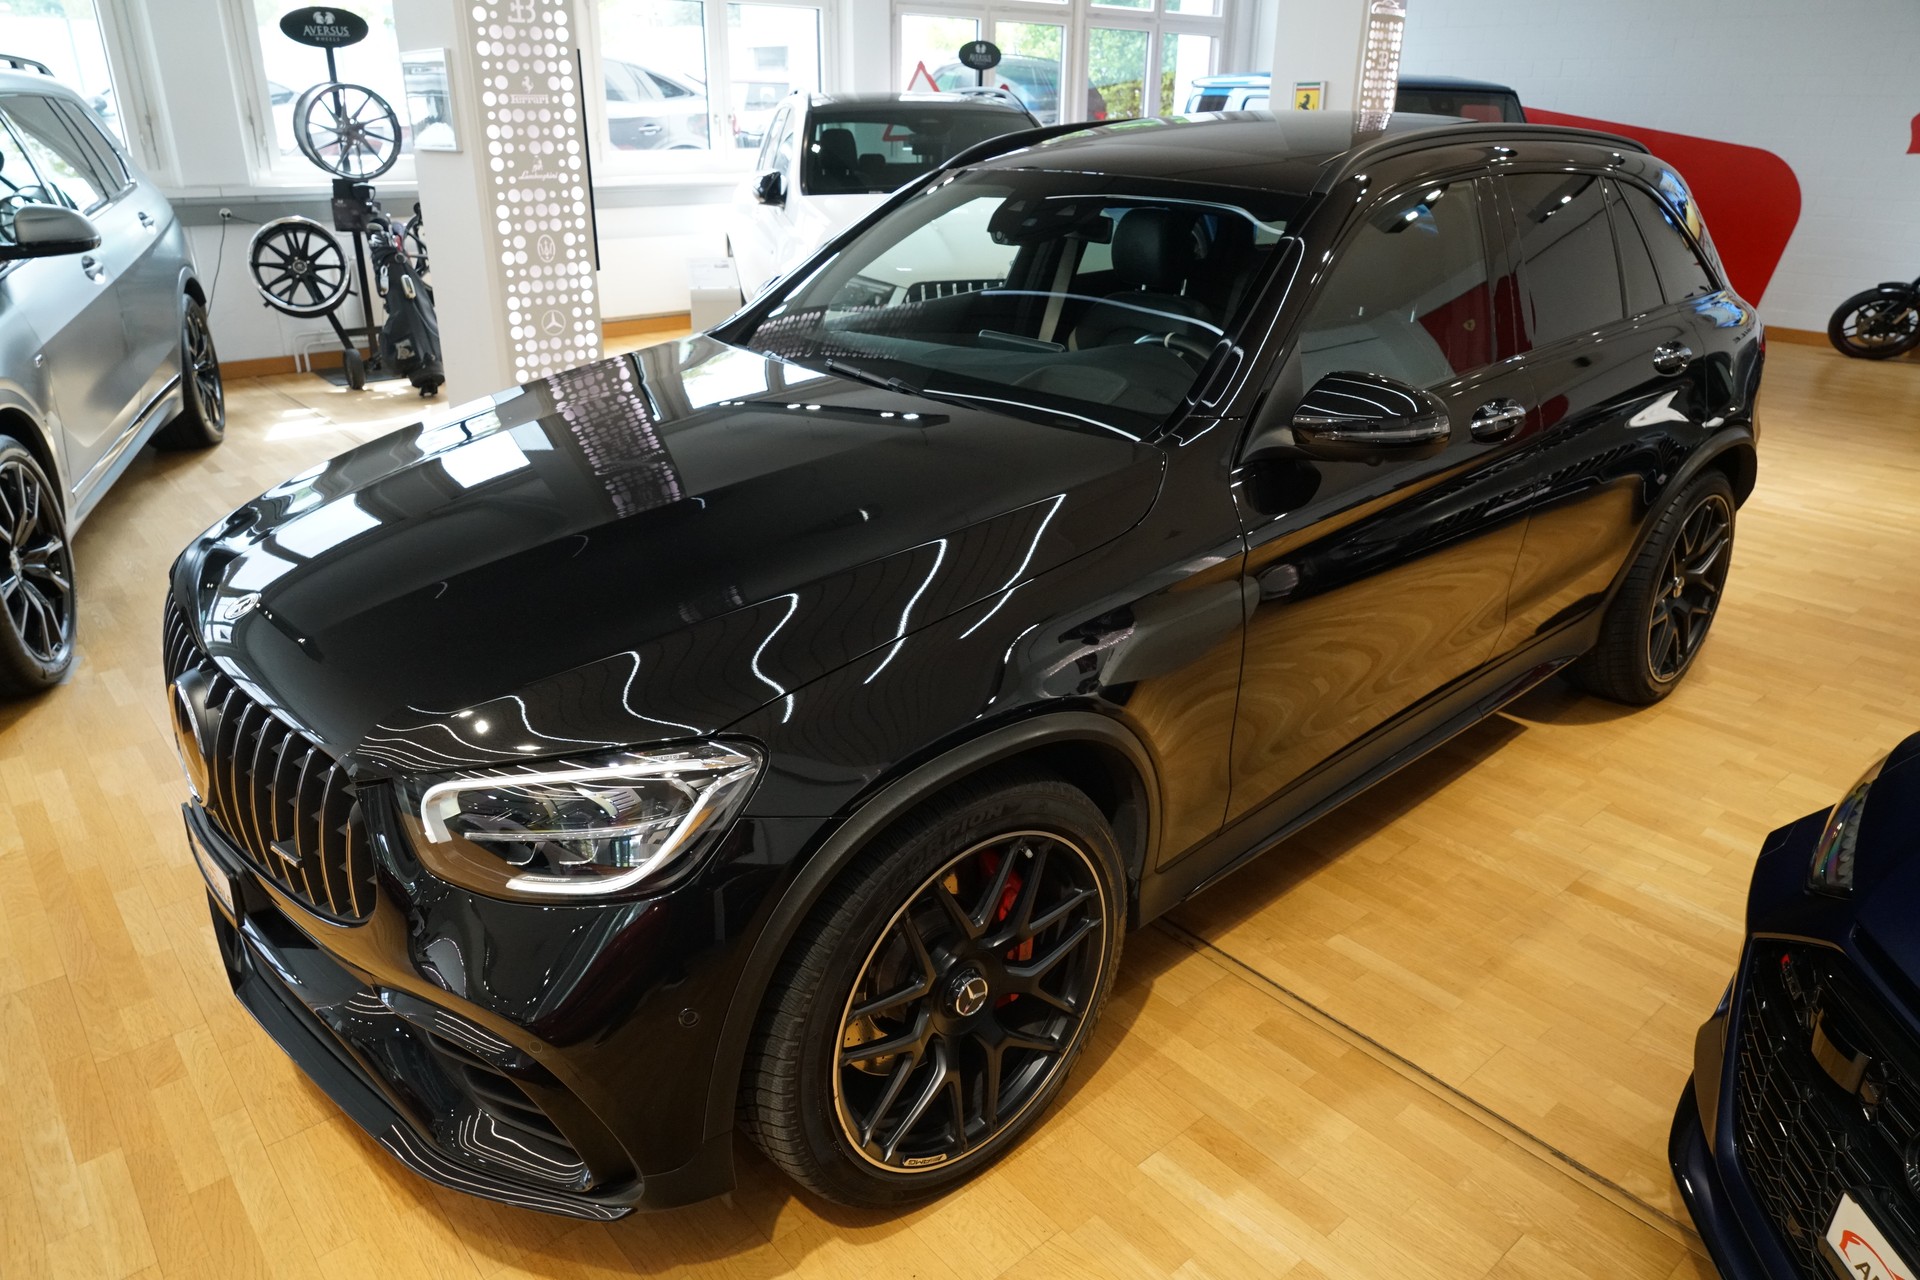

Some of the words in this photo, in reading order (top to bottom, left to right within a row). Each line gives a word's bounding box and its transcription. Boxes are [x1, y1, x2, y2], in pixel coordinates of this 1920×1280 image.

[303, 25, 350, 37] AVERSUS
[510, 94, 550, 104] Ferrari
[518, 170, 558, 181] Lamborghini
